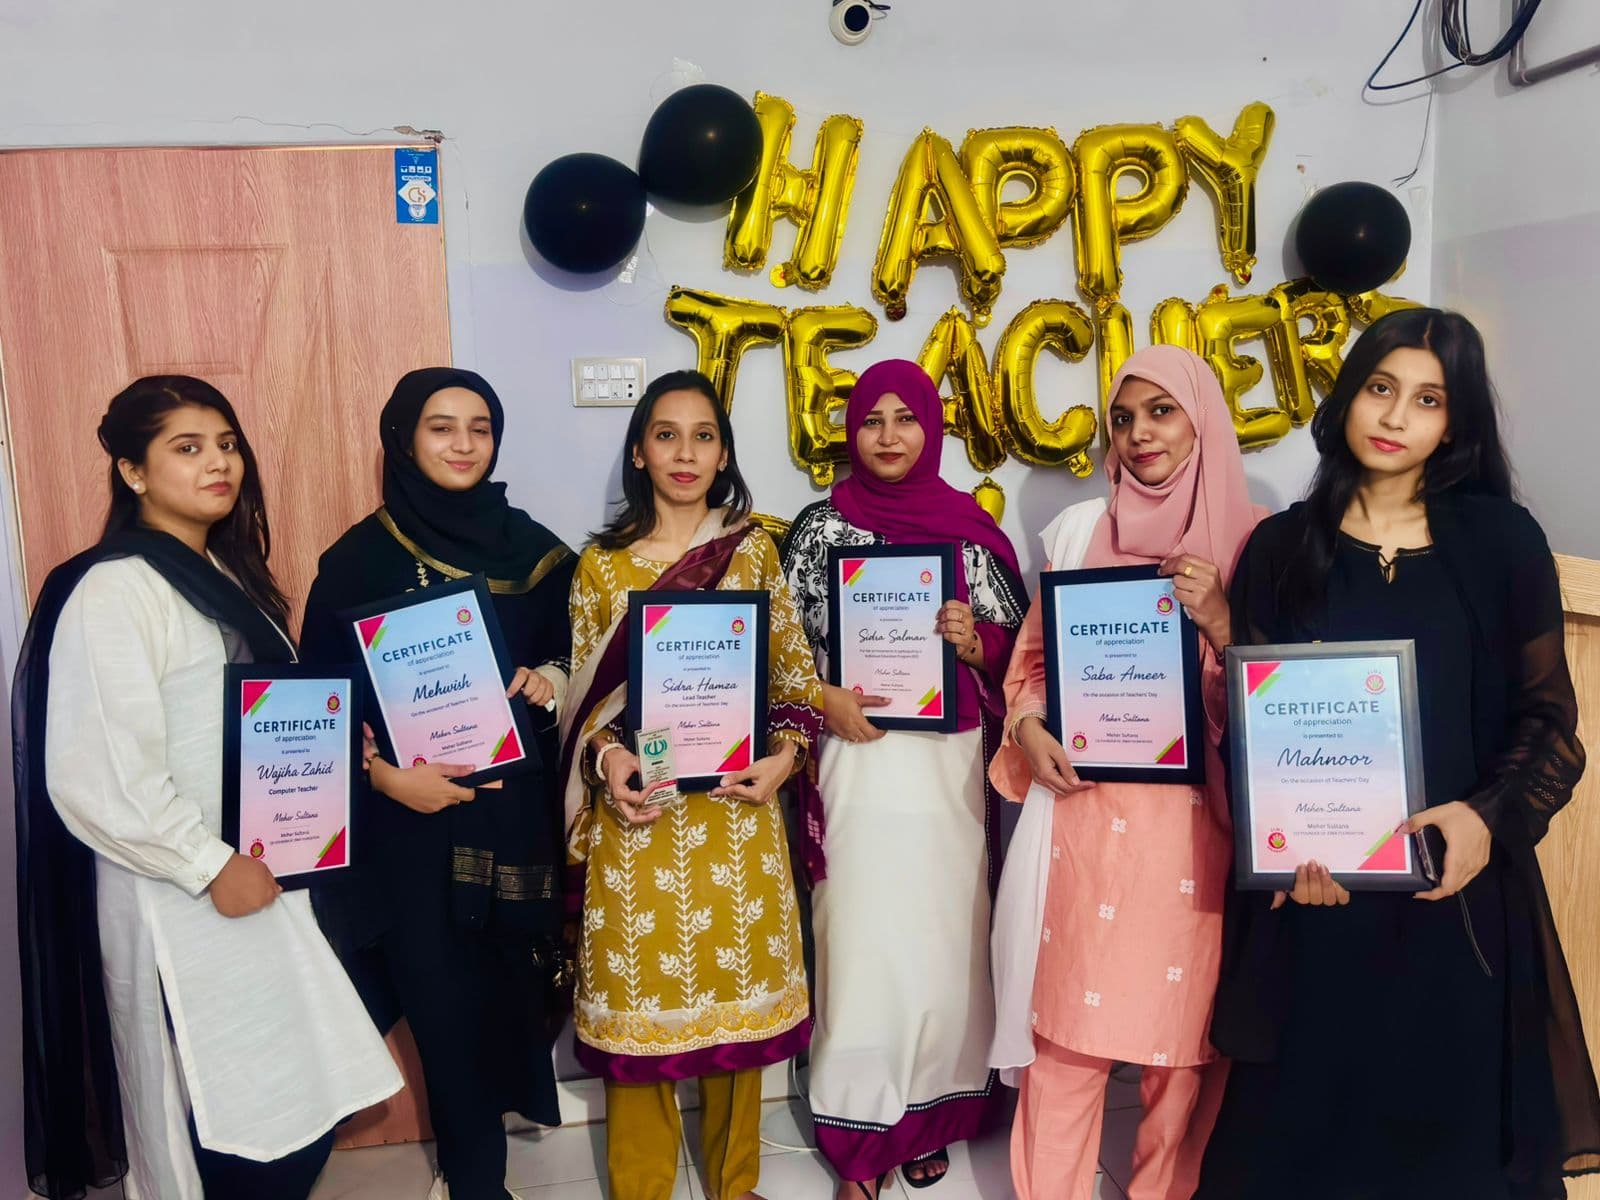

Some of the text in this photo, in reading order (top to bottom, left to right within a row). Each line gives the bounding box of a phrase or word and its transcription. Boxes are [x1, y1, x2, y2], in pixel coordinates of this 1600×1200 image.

[722, 89, 1275, 320] HAPPY
[853, 592, 930, 602] CERTIFICATE
[858, 628, 927, 643] Sidra Salman
[1070, 621, 1169, 636] CERTIFICATE
[382, 630, 473, 663] CERTIFICATE
[656, 640, 741, 652] CERTIFICATE
[1104, 638, 1144, 646] appreciation
[407, 650, 455, 667] of appreciation
[1081, 665, 1166, 682] Saba Ameer
[412, 674, 472, 703] Mehwish
[661, 677, 738, 694] Sidra Hamza
[1265, 700, 1380, 715] CERTIFICATE
[254, 719, 336, 733] CERTIFICATE
[1293, 718, 1352, 727] of appreciation
[282, 734, 316, 742] appreciation
[1308, 732, 1336, 740] presented
[1277, 748, 1373, 767] Mahnoor
[257, 761, 334, 784] Wajiha Zahid
[268, 787, 296, 795] Computer
